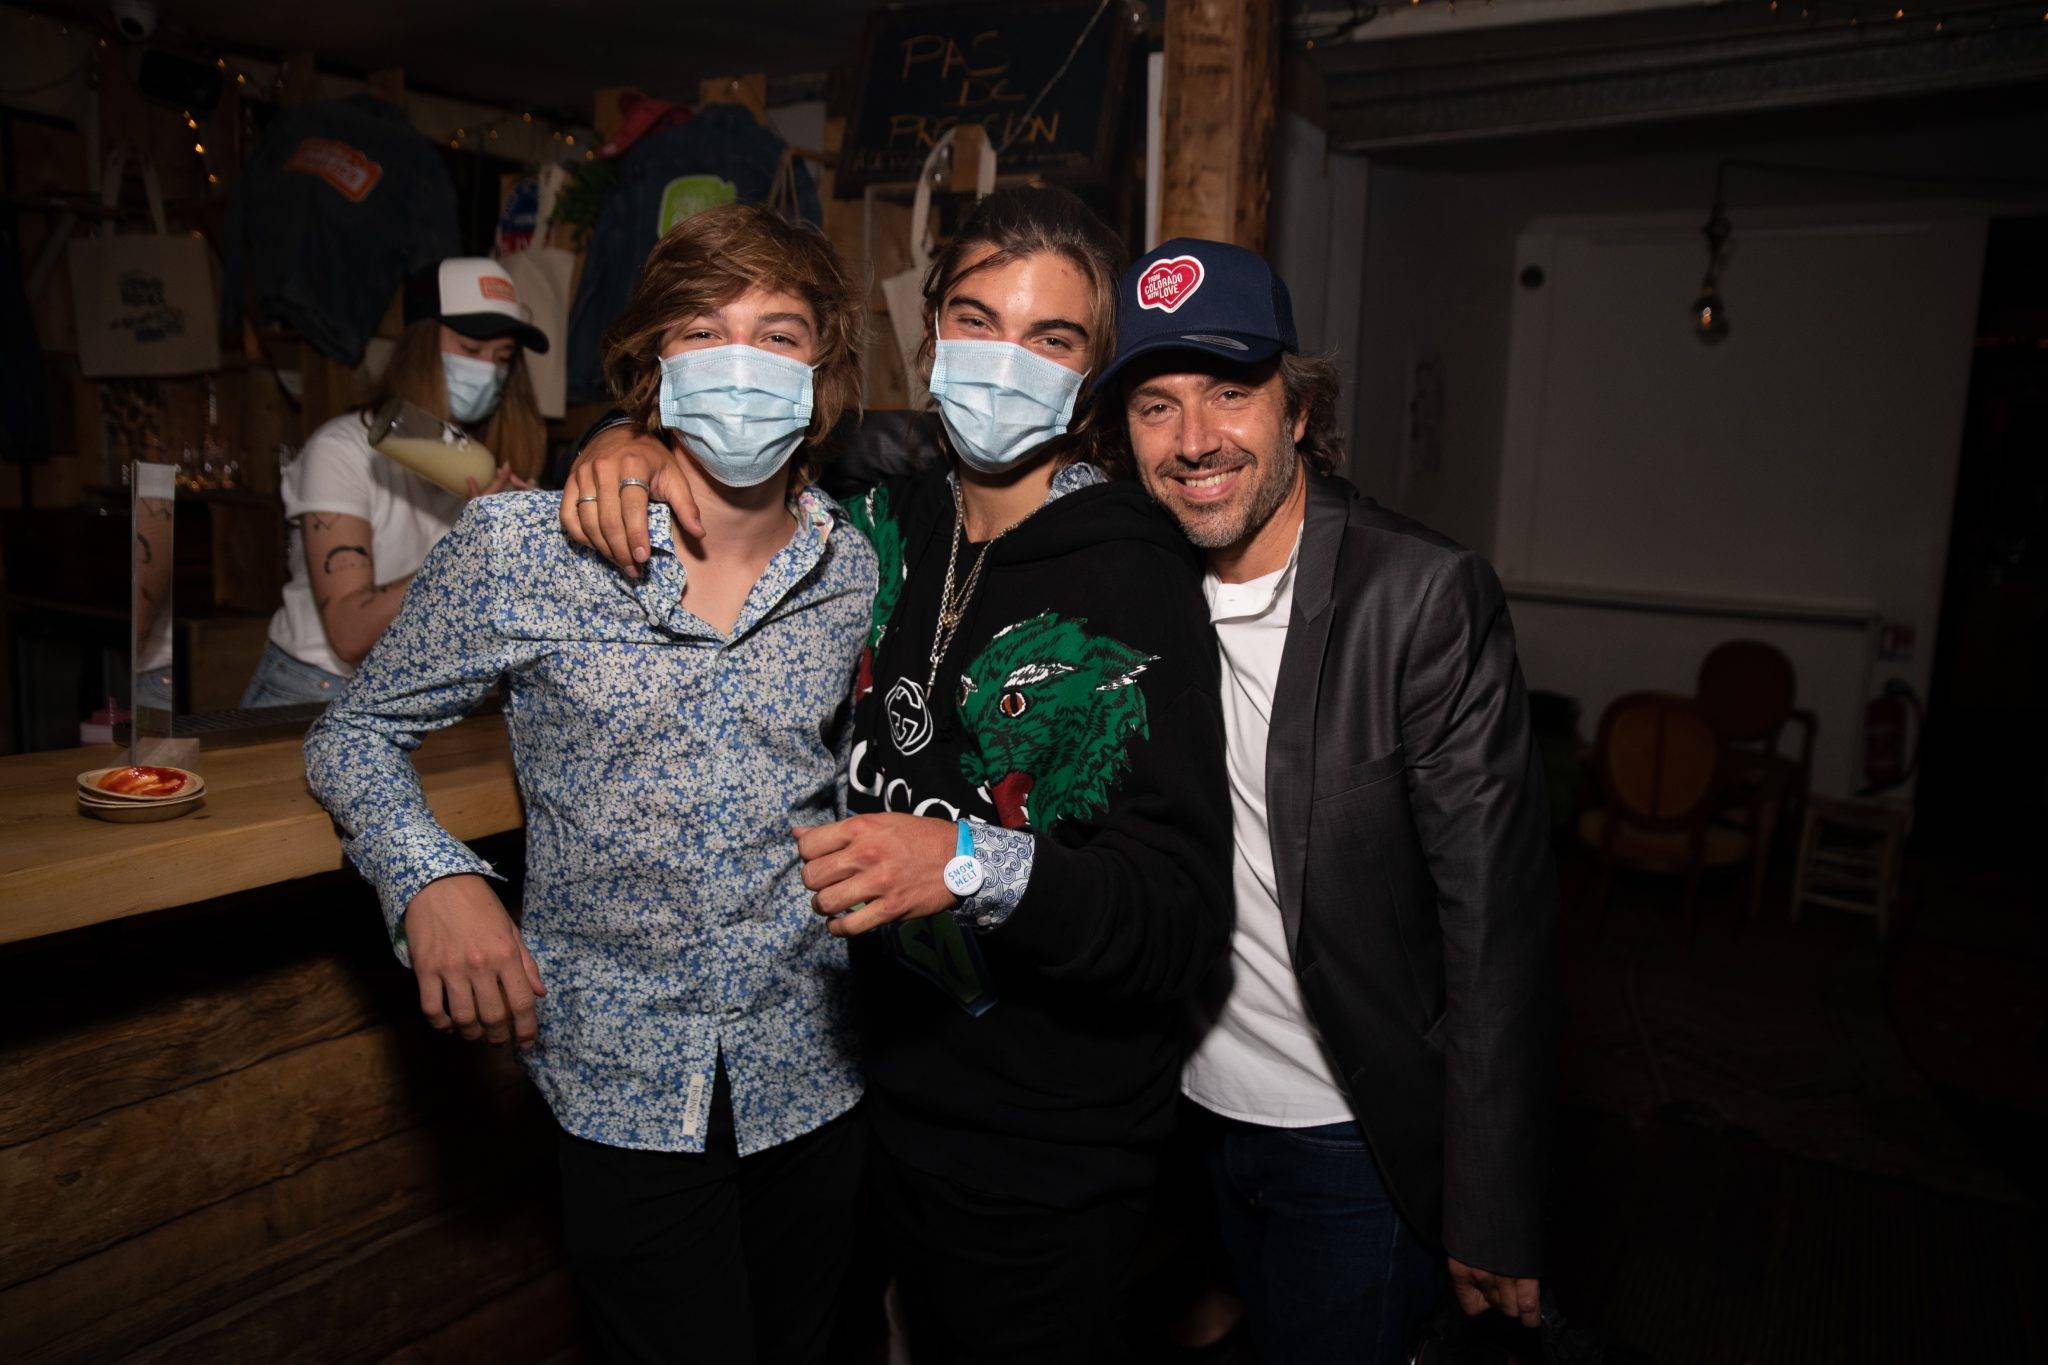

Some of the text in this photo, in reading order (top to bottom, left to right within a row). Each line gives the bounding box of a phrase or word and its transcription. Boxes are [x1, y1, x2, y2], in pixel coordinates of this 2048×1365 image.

[901, 31, 1010, 80] PAS
[1144, 272, 1183, 296] COLORADO
[1159, 283, 1180, 299] LOVE
[948, 859, 975, 881] SNOW
[954, 869, 977, 888] MELT
